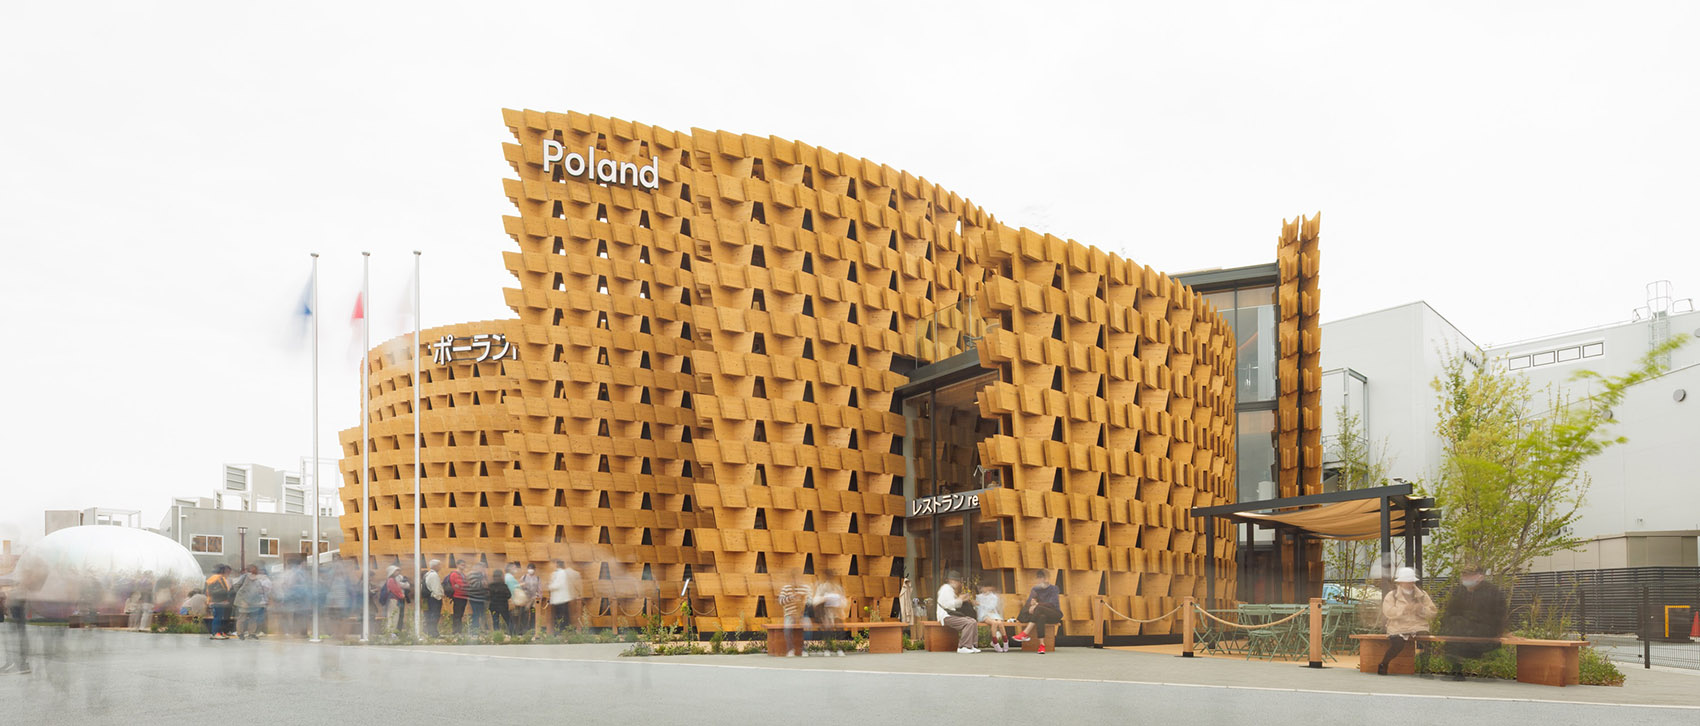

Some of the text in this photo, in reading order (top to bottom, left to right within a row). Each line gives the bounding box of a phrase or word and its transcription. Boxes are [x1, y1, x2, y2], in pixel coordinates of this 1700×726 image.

[543, 139, 659, 190] Poland
[912, 494, 981, 516] レストラン re
